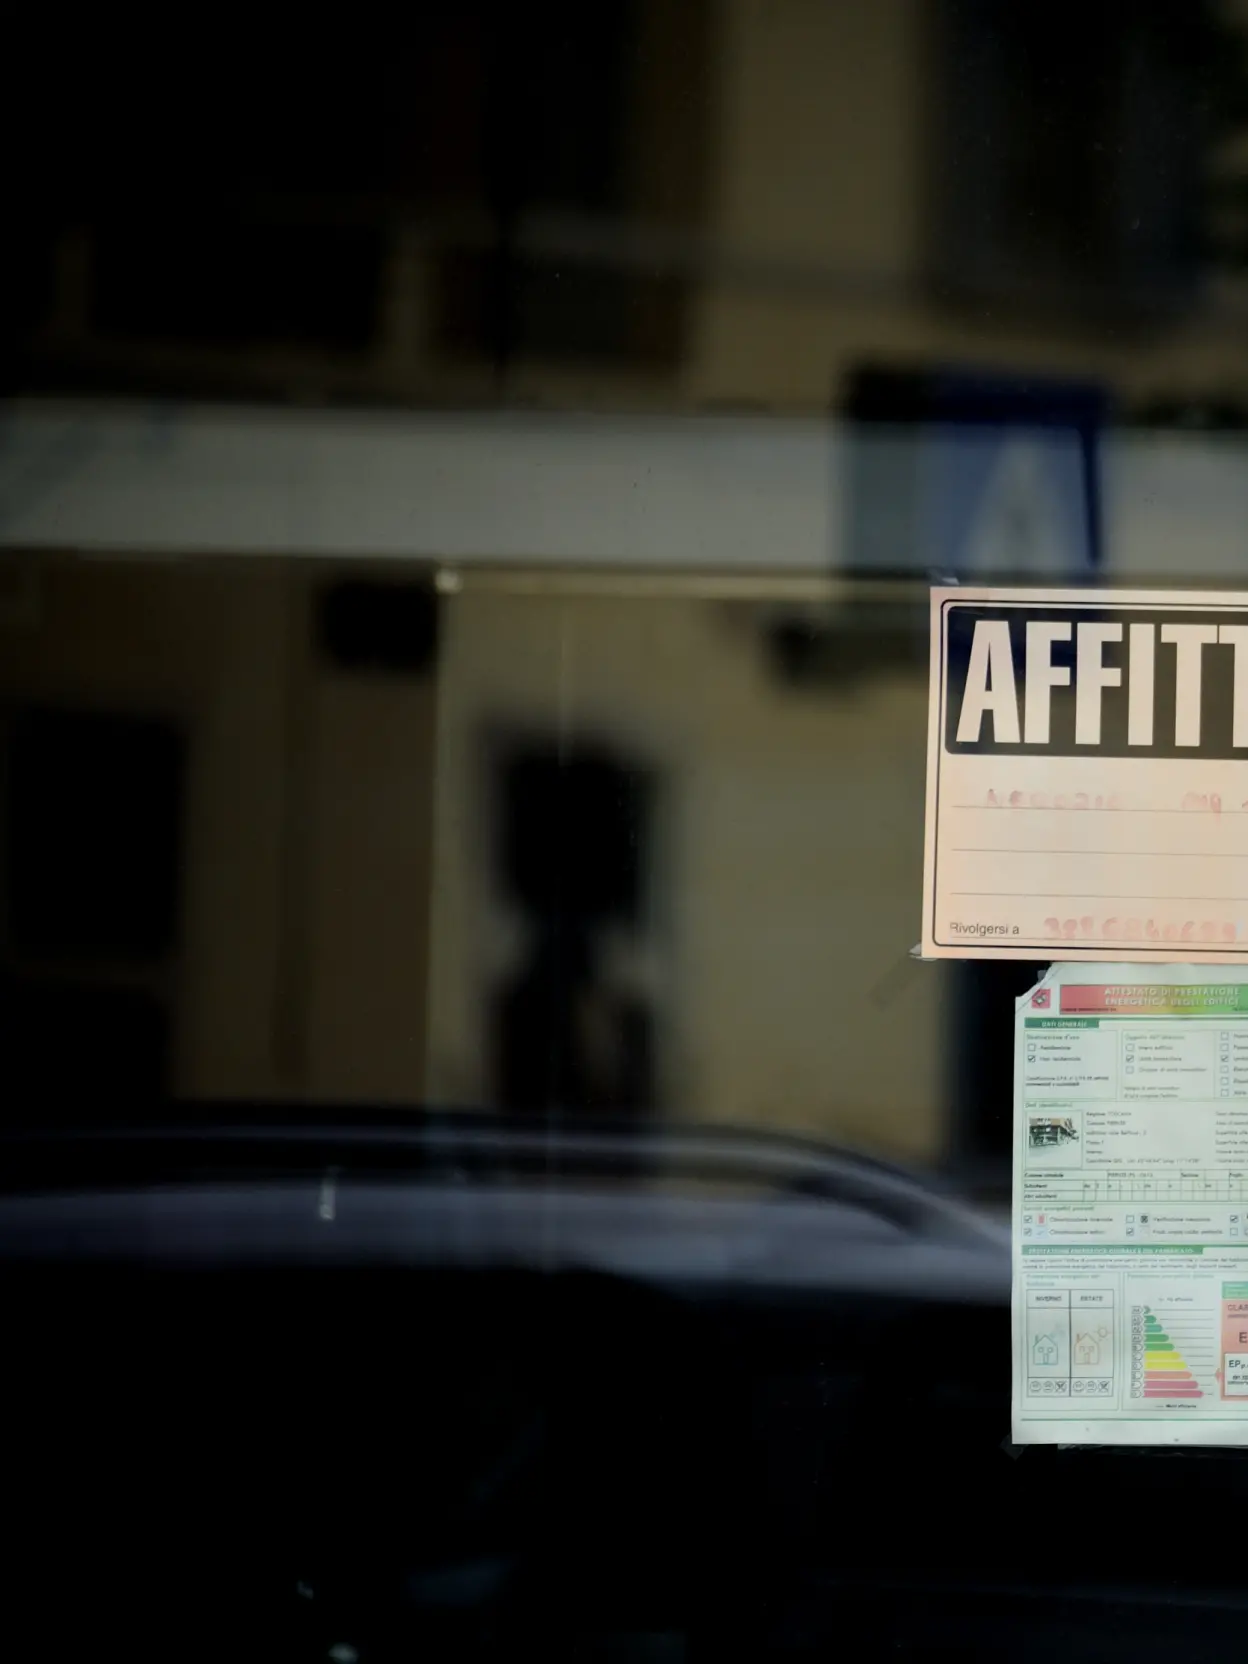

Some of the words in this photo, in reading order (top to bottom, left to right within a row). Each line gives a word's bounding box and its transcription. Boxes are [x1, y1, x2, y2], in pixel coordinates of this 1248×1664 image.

[950, 922, 1009, 936] Rivolgersi
[1012, 925, 1020, 935] a
[1238, 1331, 1248, 1344] E
